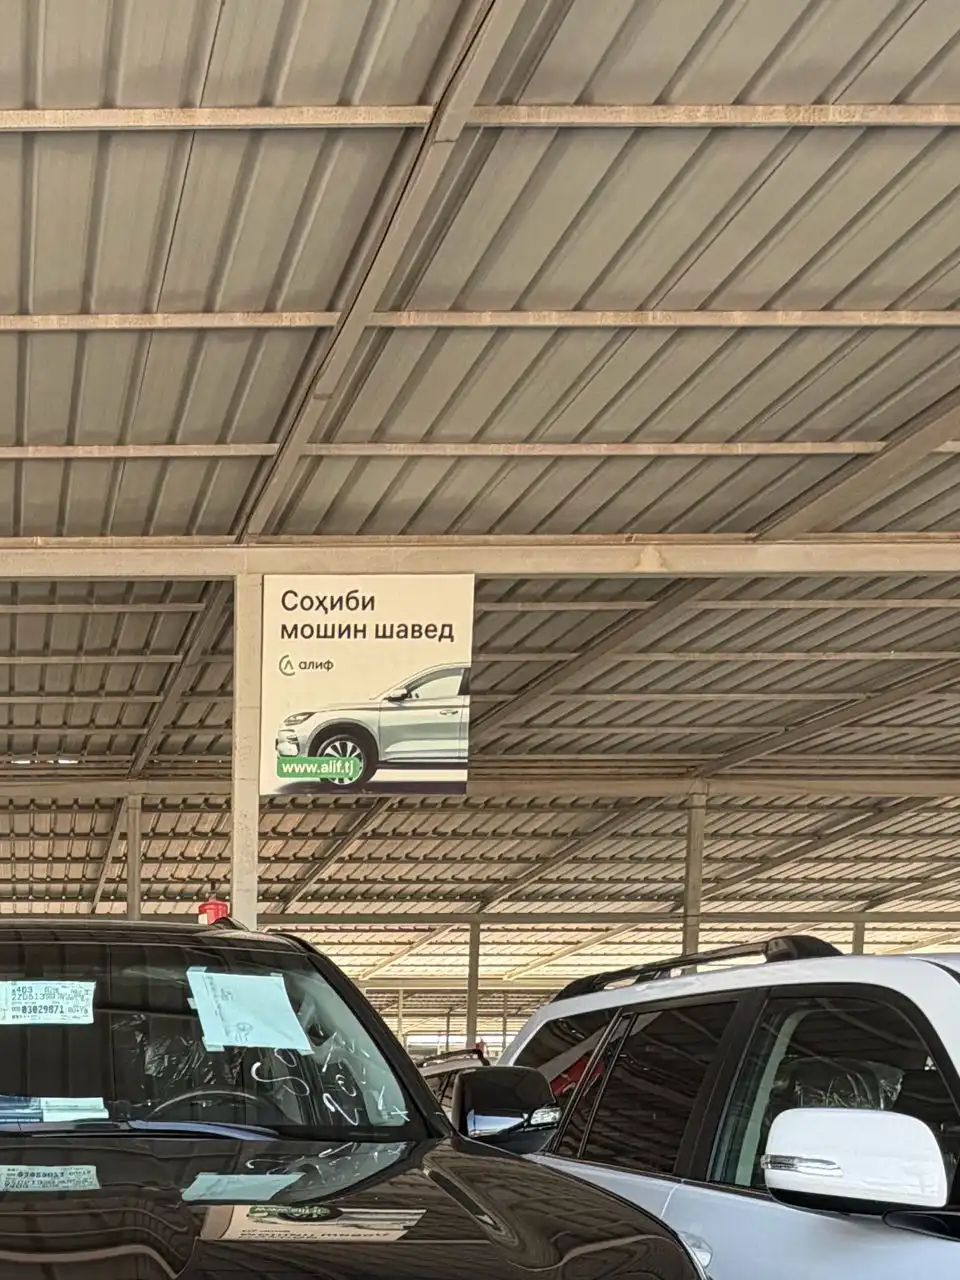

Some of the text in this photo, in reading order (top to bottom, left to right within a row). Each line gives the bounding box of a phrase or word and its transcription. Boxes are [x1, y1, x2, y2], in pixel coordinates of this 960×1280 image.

[281, 590, 376, 614] Соҳиби
[280, 623, 455, 643] мошин шавед
[298, 658, 334, 672] алиф
[281, 760, 354, 776] www.alif.tj
